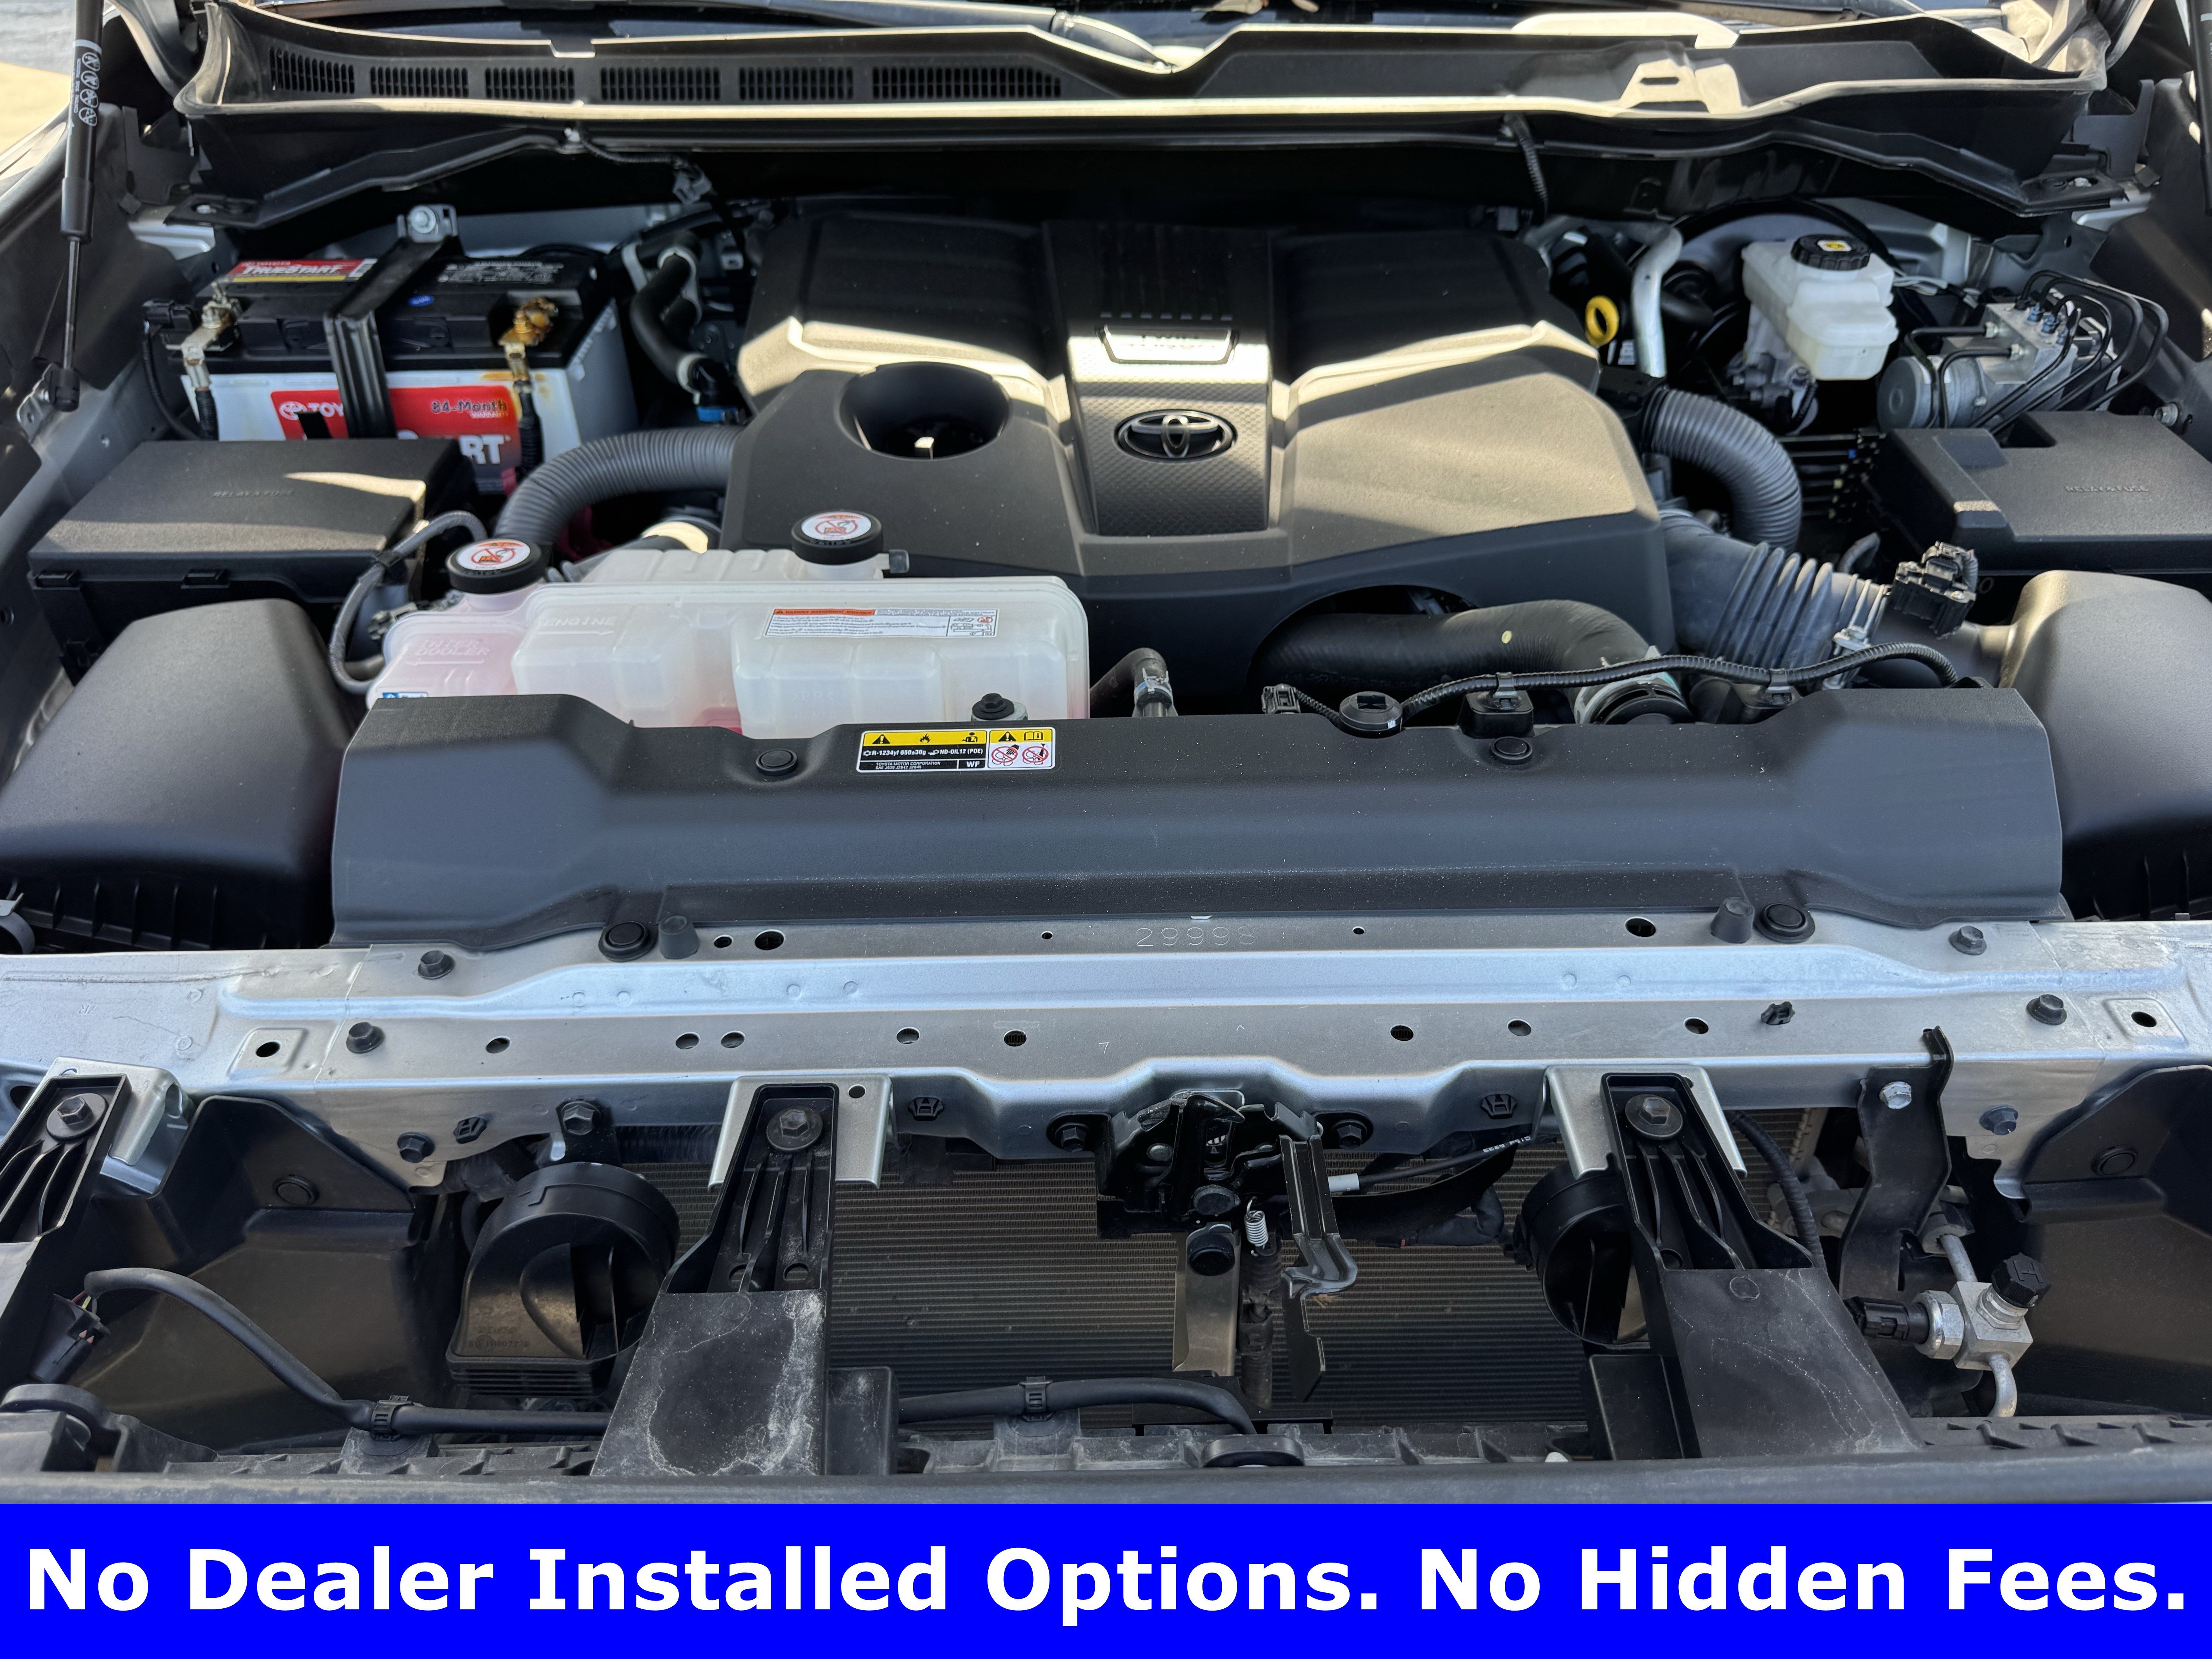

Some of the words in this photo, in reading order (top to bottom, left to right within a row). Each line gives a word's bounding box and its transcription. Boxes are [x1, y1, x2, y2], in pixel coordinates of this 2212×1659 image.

[307, 402, 343, 417] TOY
[431, 399, 508, 413] 84-Month
[1135, 926, 1258, 946] 29998
